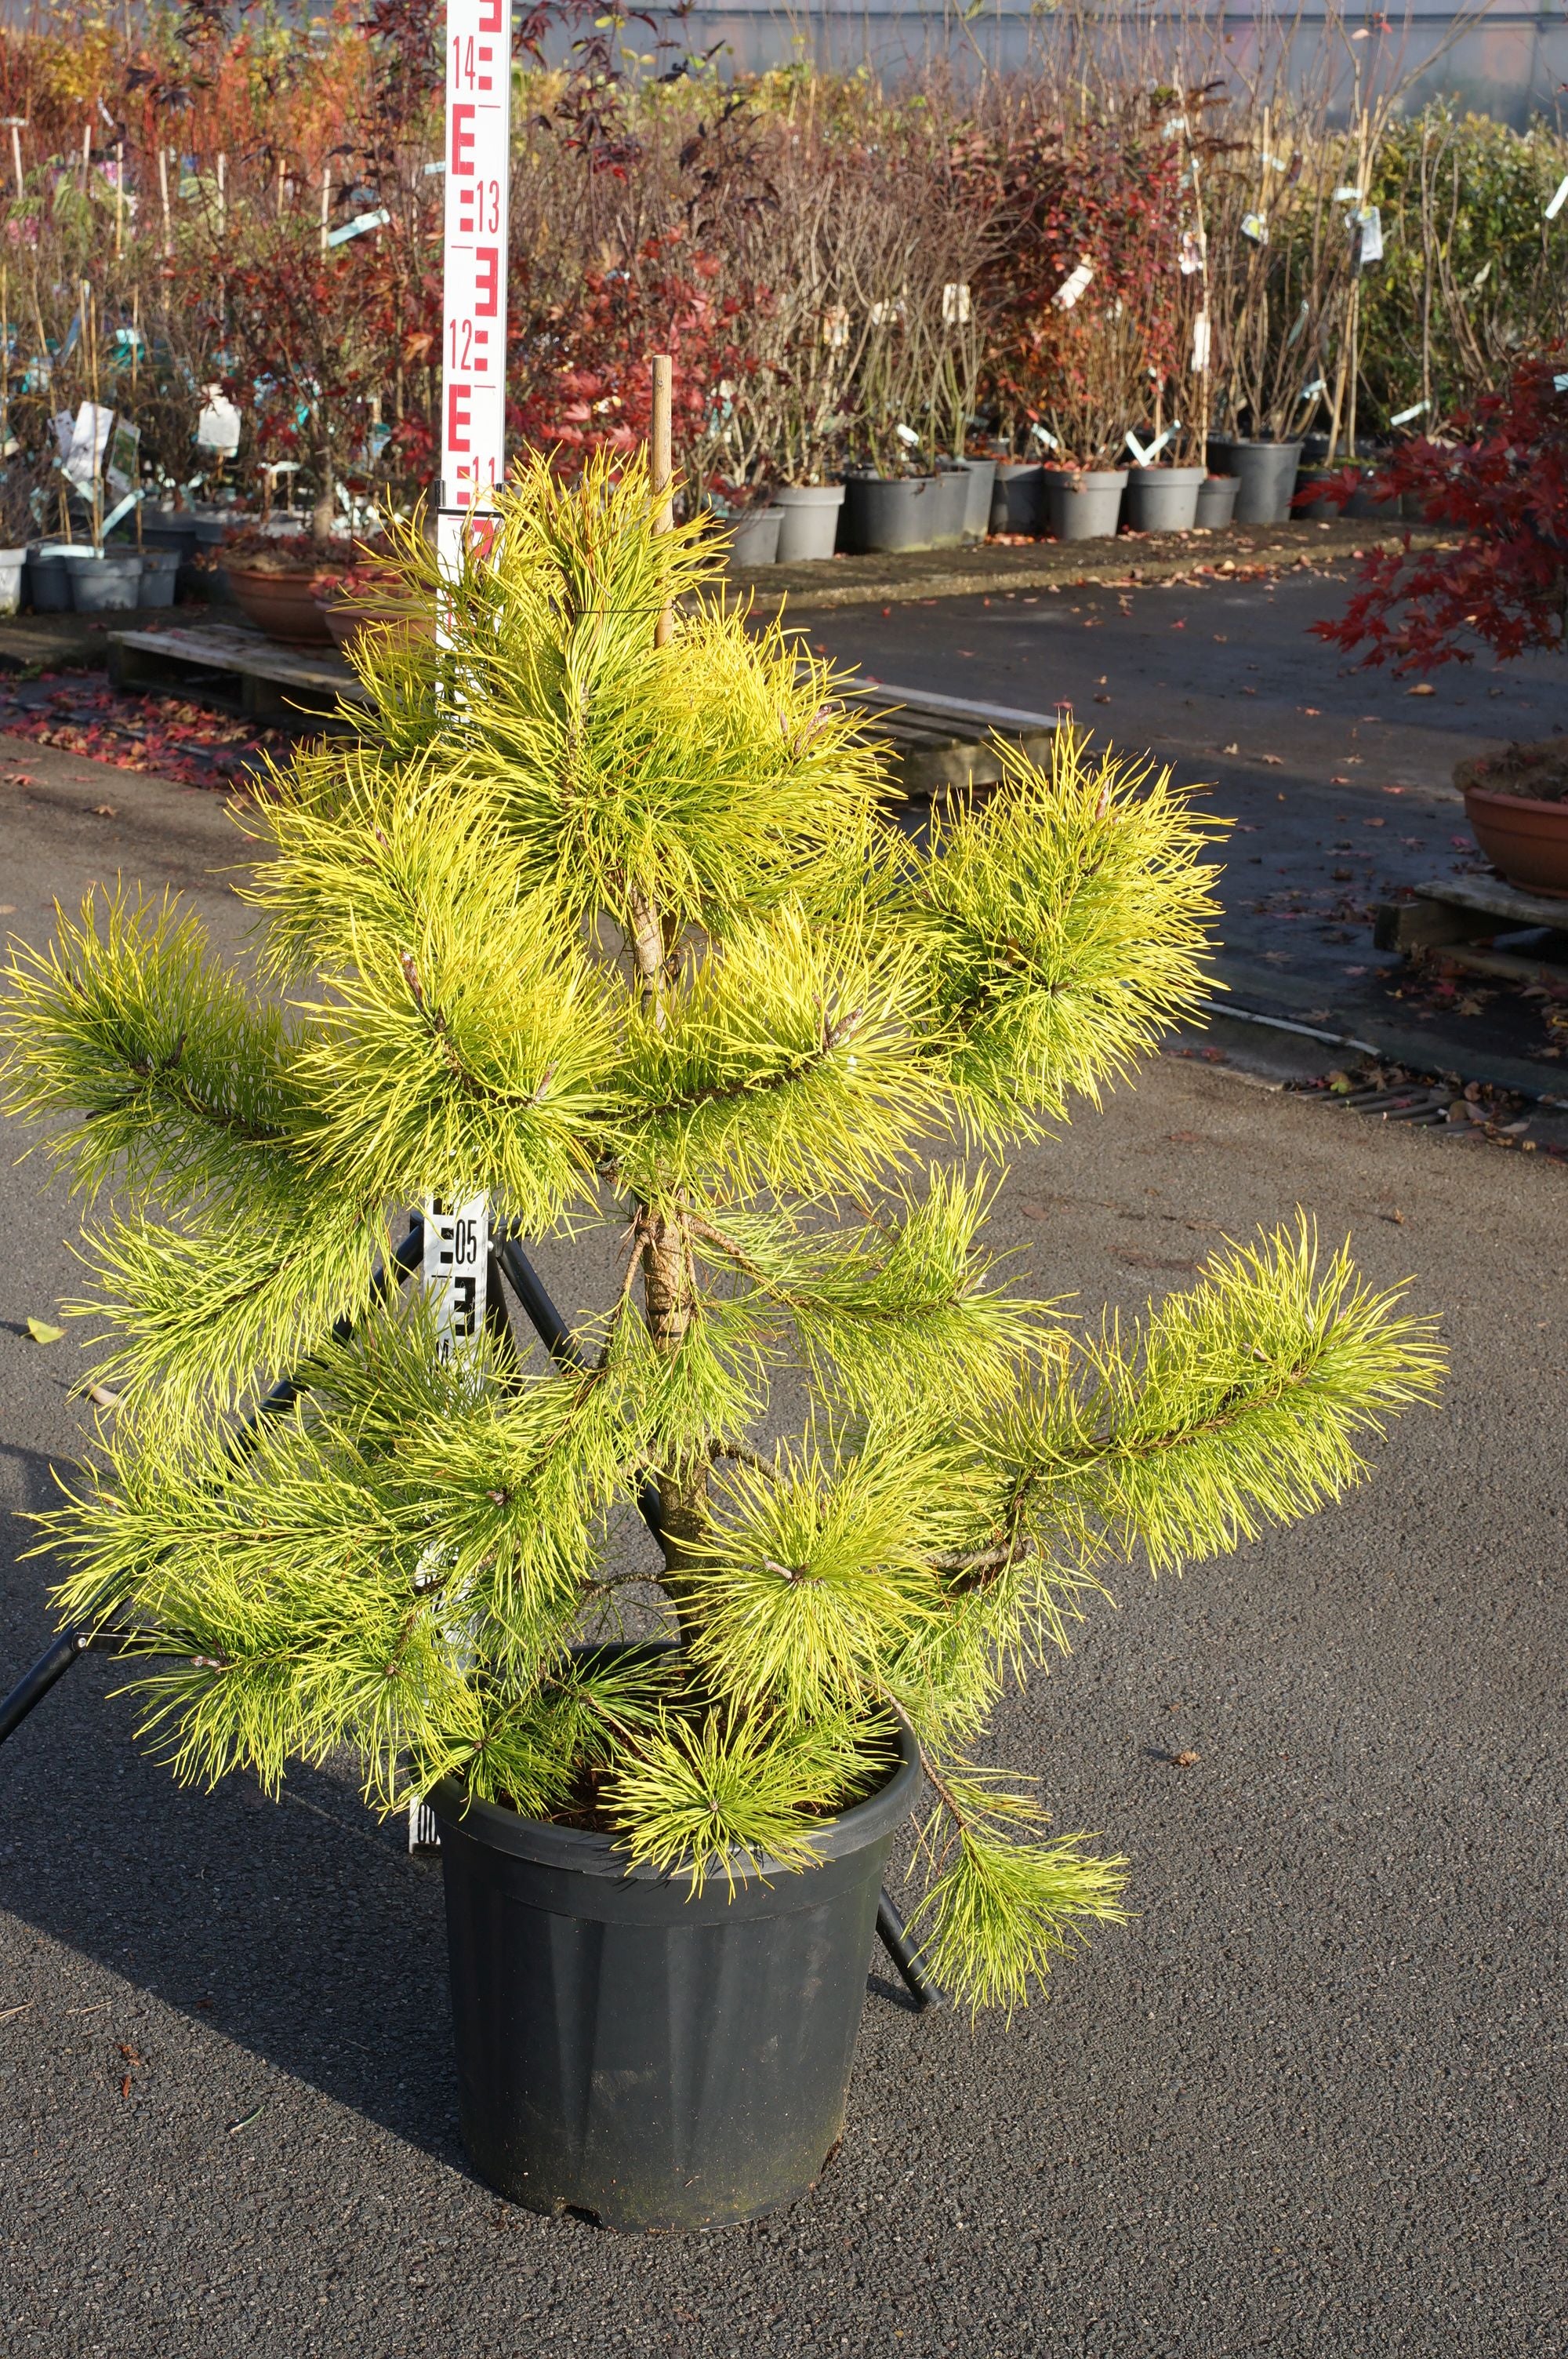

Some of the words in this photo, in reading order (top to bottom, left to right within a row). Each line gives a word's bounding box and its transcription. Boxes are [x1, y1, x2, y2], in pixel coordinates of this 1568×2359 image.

[452, 35, 476, 90] 14
[477, 180, 500, 234] 13
[449, 318, 471, 371] 12
[472, 456, 495, 503] 11
[455, 1218, 477, 1265] 05
